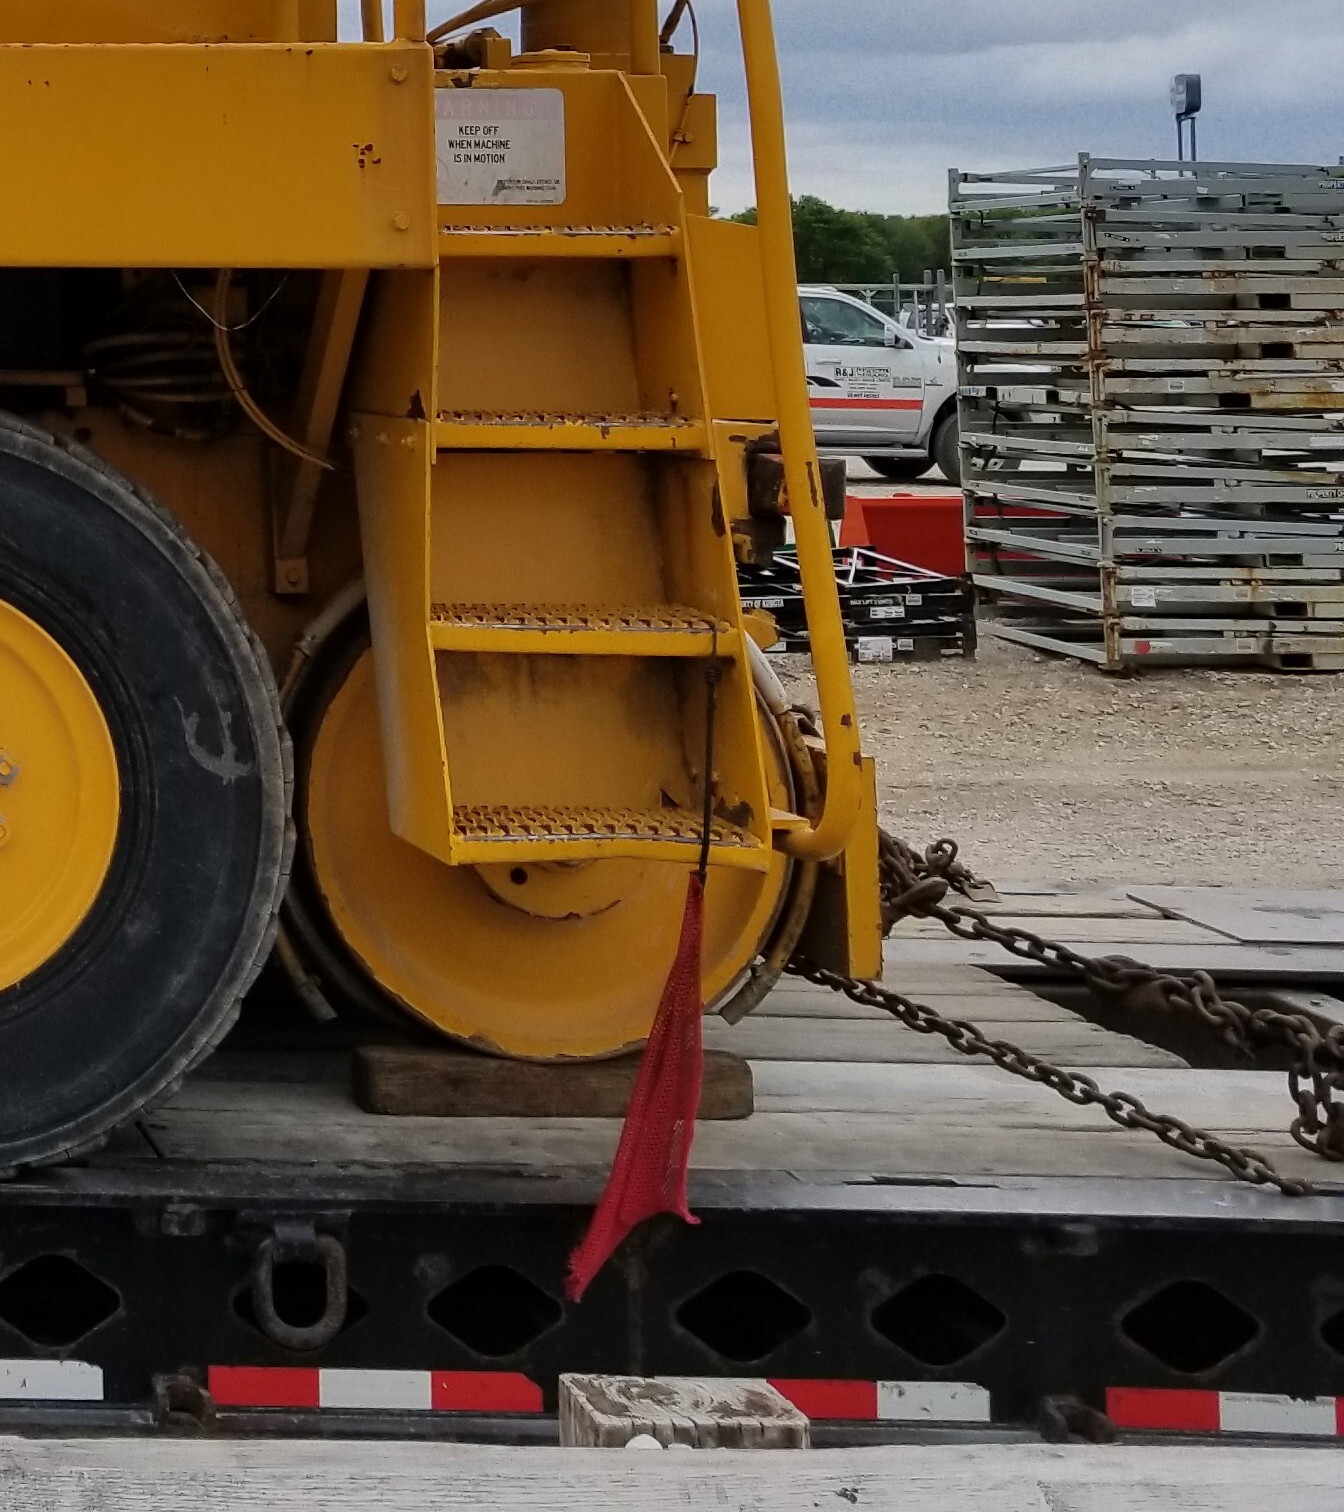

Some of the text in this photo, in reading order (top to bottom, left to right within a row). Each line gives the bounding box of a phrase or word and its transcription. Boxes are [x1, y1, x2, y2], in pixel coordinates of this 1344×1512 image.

[442, 97, 536, 117] ARNING
[458, 125, 500, 136] KEEP OFF
[447, 139, 511, 150] WHEN MACHINE
[453, 153, 506, 164] IS IN MOTION
